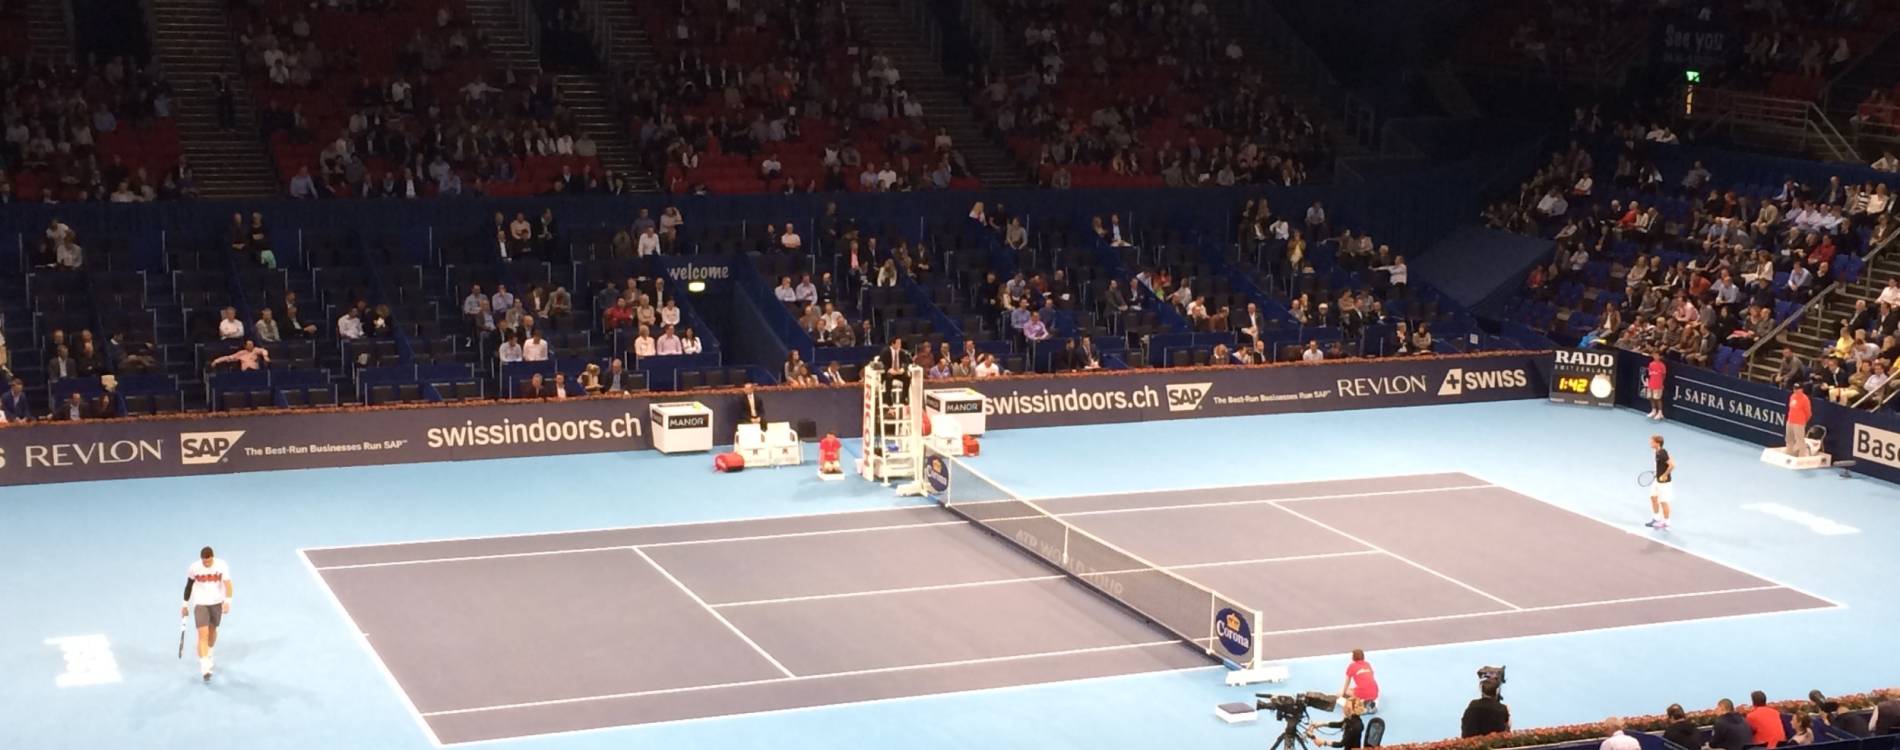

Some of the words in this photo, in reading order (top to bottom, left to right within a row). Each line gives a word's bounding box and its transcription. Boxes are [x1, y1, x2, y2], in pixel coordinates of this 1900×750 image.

[1664, 24, 1690, 47] See
[667, 262, 729, 280] welcome
[1555, 350, 1614, 367] RADO
[1337, 375, 1427, 397] REVLON
[1465, 369, 1527, 390] SWISS
[1559, 377, 1588, 392] 1:42
[947, 402, 978, 412] MANOR
[984, 385, 1159, 415] swissindoors.ch
[1169, 388, 1202, 406] SAP
[1673, 385, 1682, 400] J.
[1685, 388, 1724, 410] SAFRA
[1729, 400, 1785, 426] SARASIN
[427, 412, 642, 448] swissindoors.ch
[669, 417, 704, 427] MANOR
[25, 439, 162, 468] REVLON
[182, 437, 230, 458] SAP
[244, 447, 263, 456] The
[265, 445, 308, 455] Best-Run
[310, 443, 361, 453] Businesses
[363, 441, 382, 450] Run
[1858, 429, 1900, 462] Bas
[1216, 619, 1249, 649] Corona
